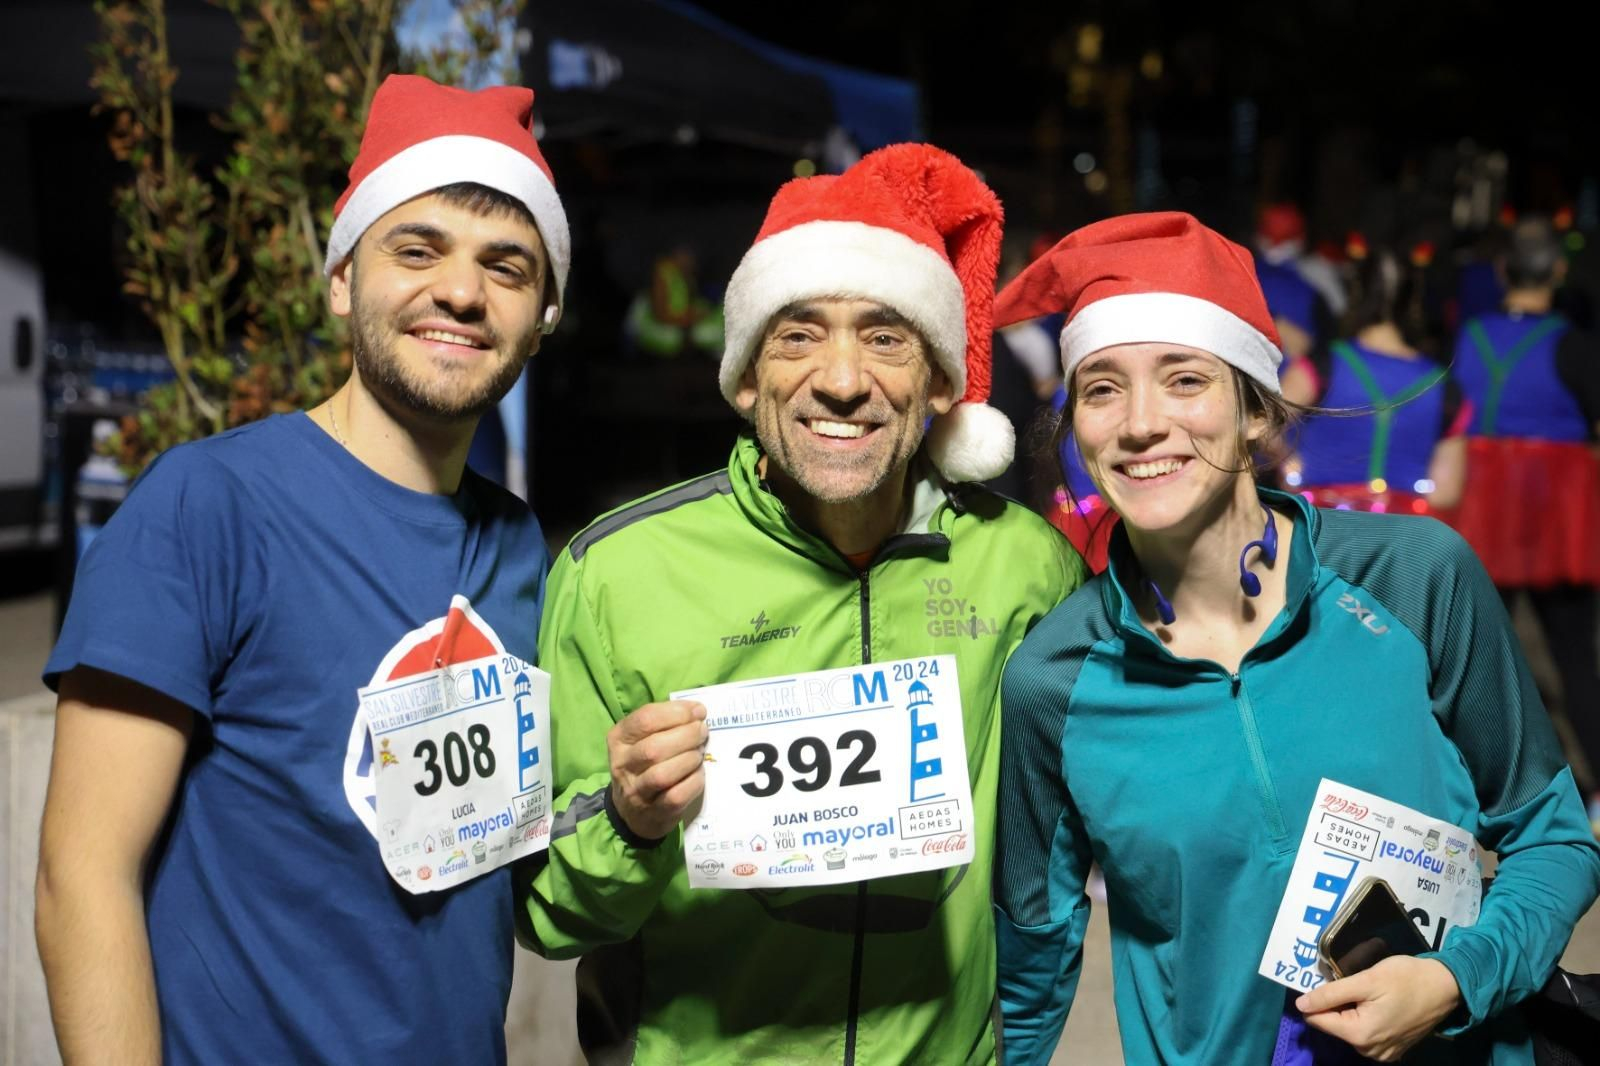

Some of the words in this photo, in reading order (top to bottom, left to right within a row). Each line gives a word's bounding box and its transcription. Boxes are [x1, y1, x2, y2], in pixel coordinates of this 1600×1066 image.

[922, 577, 952, 595] YO
[925, 598, 968, 617] SOY
[720, 625, 802, 649] TEAMERGY
[364, 696, 391, 720] SAN
[393, 681, 442, 711] SILVESTRE
[803, 671, 889, 713] RCM
[372, 719, 388, 730] REAL
[389, 713, 405, 728] CLUB
[706, 716, 729, 727] CLUB
[413, 723, 496, 797] 308
[738, 729, 882, 798] 392
[522, 804, 542, 819] HOMES
[772, 812, 808, 827] JUAN
[813, 805, 859, 822] BOSCO
[909, 808, 951, 821] AEDAS
[458, 807, 513, 841] mayoral
[803, 817, 895, 847] mayoral
[910, 818, 952, 832] HOMES
[1330, 822, 1370, 842] HOMES
[440, 835, 455, 848] YOU
[773, 829, 795, 841] Only
[776, 838, 796, 849] YOU
[1326, 833, 1367, 851] AEDAS
[692, 840, 745, 852] ACER
[1379, 840, 1445, 874] mayoral
[768, 863, 815, 876] Electrolit
[1417, 876, 1441, 895] LUISA
